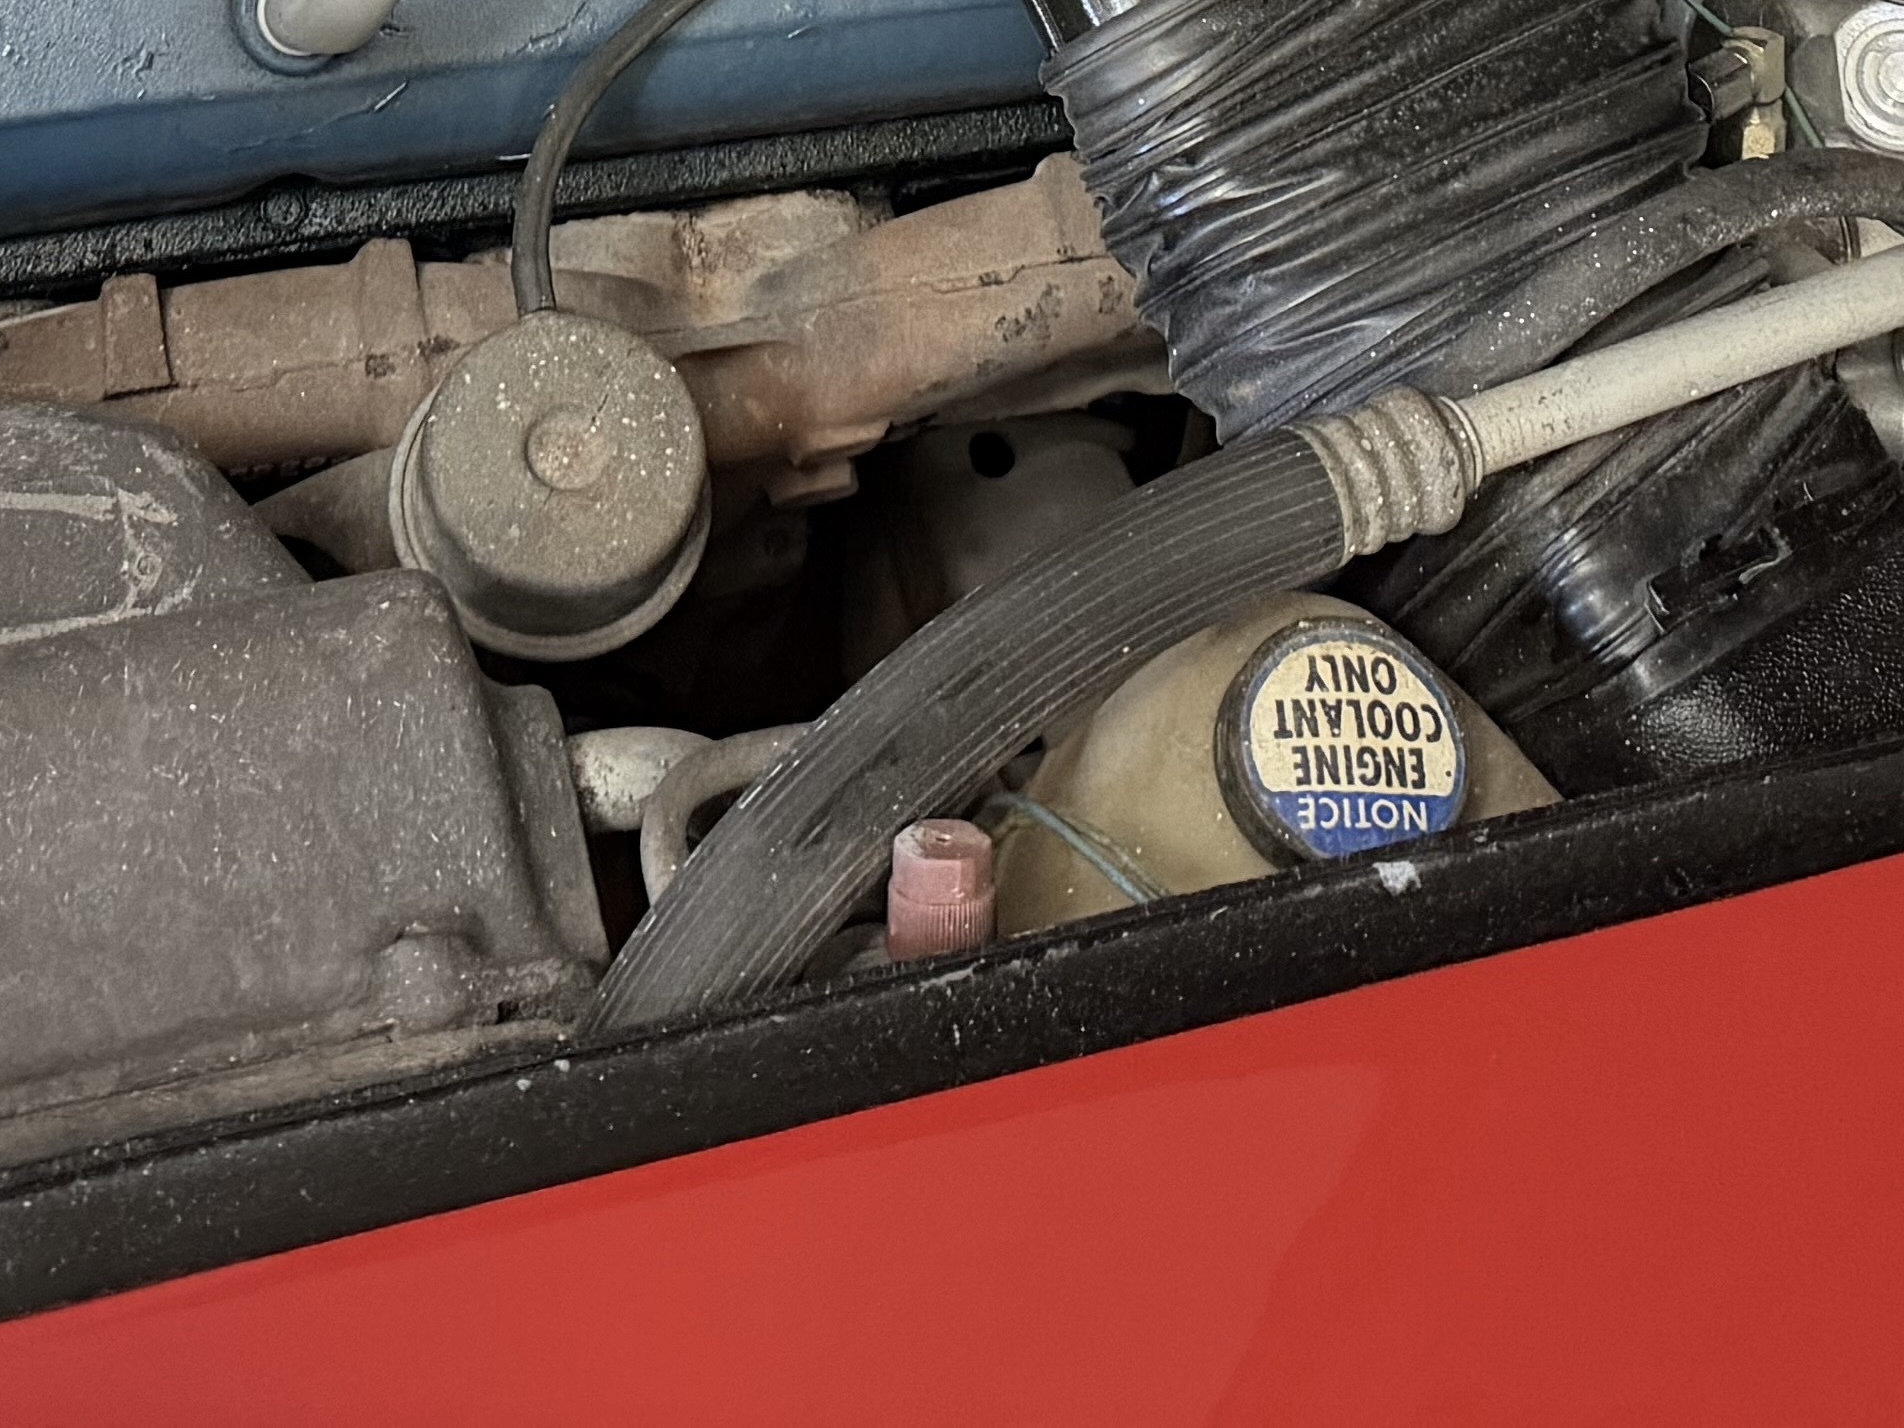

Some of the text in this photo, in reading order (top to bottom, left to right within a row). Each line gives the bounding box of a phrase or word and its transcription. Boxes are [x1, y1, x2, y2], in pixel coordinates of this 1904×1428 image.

[1305, 655, 1397, 694] ONLY
[1274, 698, 1443, 743] COOLANT
[1292, 745, 1426, 789] ENGINE
[1297, 796, 1428, 832] NOTICE
